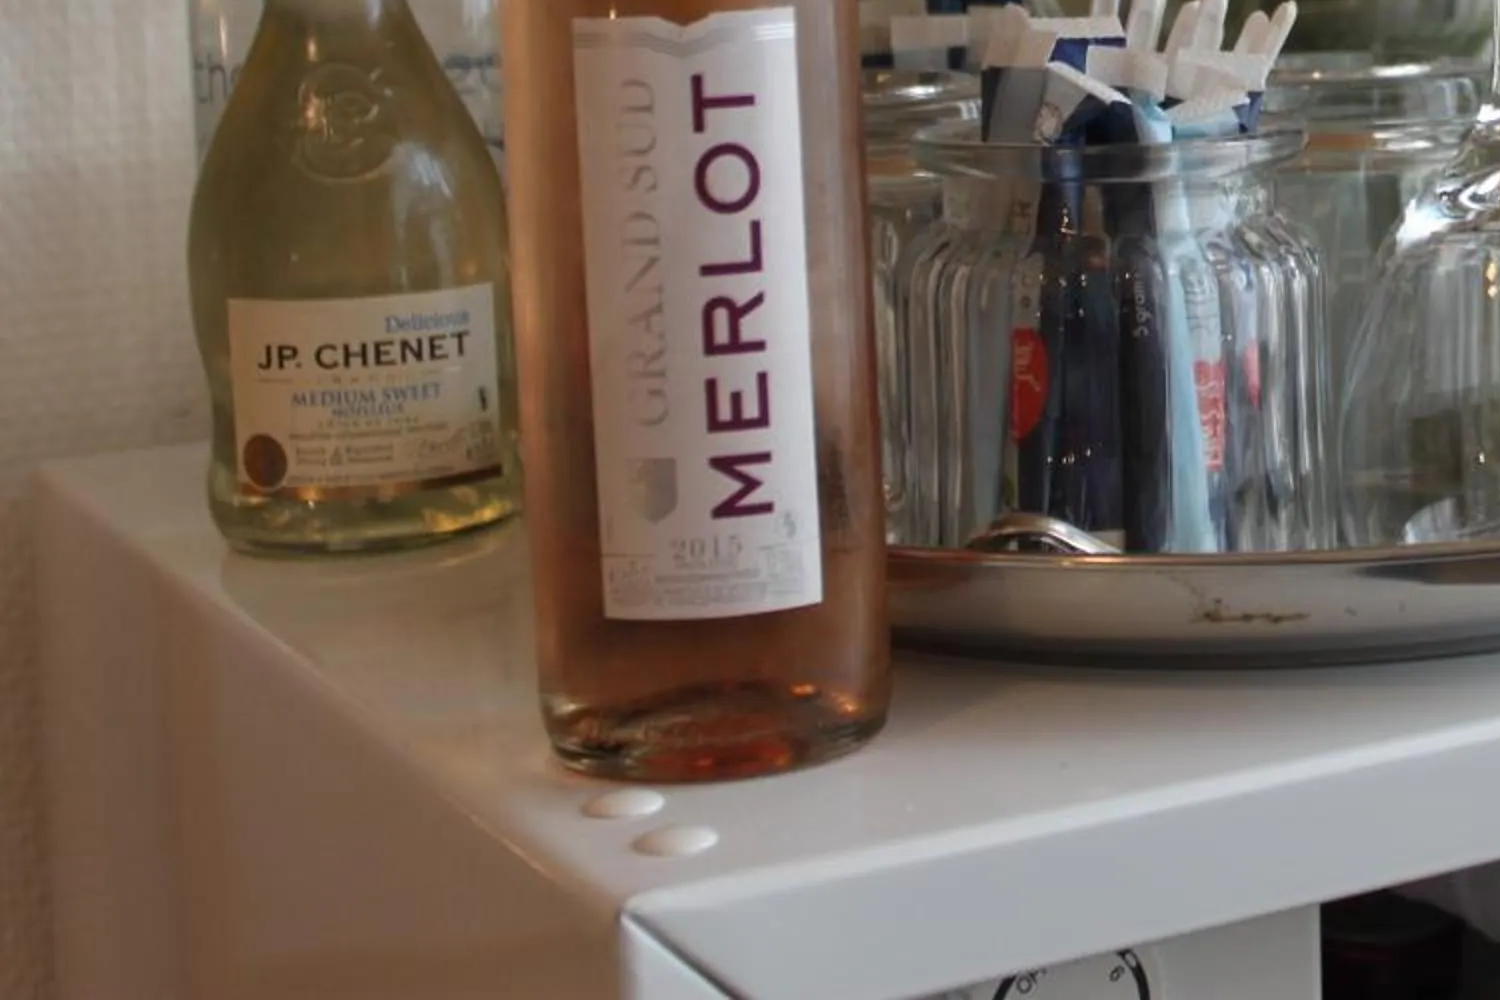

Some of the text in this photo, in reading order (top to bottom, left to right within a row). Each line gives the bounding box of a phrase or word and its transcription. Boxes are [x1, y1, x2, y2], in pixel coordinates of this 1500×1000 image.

[256, 330, 471, 371] JP. CHENET
[618, 78, 668, 428] GRAND SUD
[690, 71, 775, 520] MERLOT
[669, 534, 744, 561] 2015
